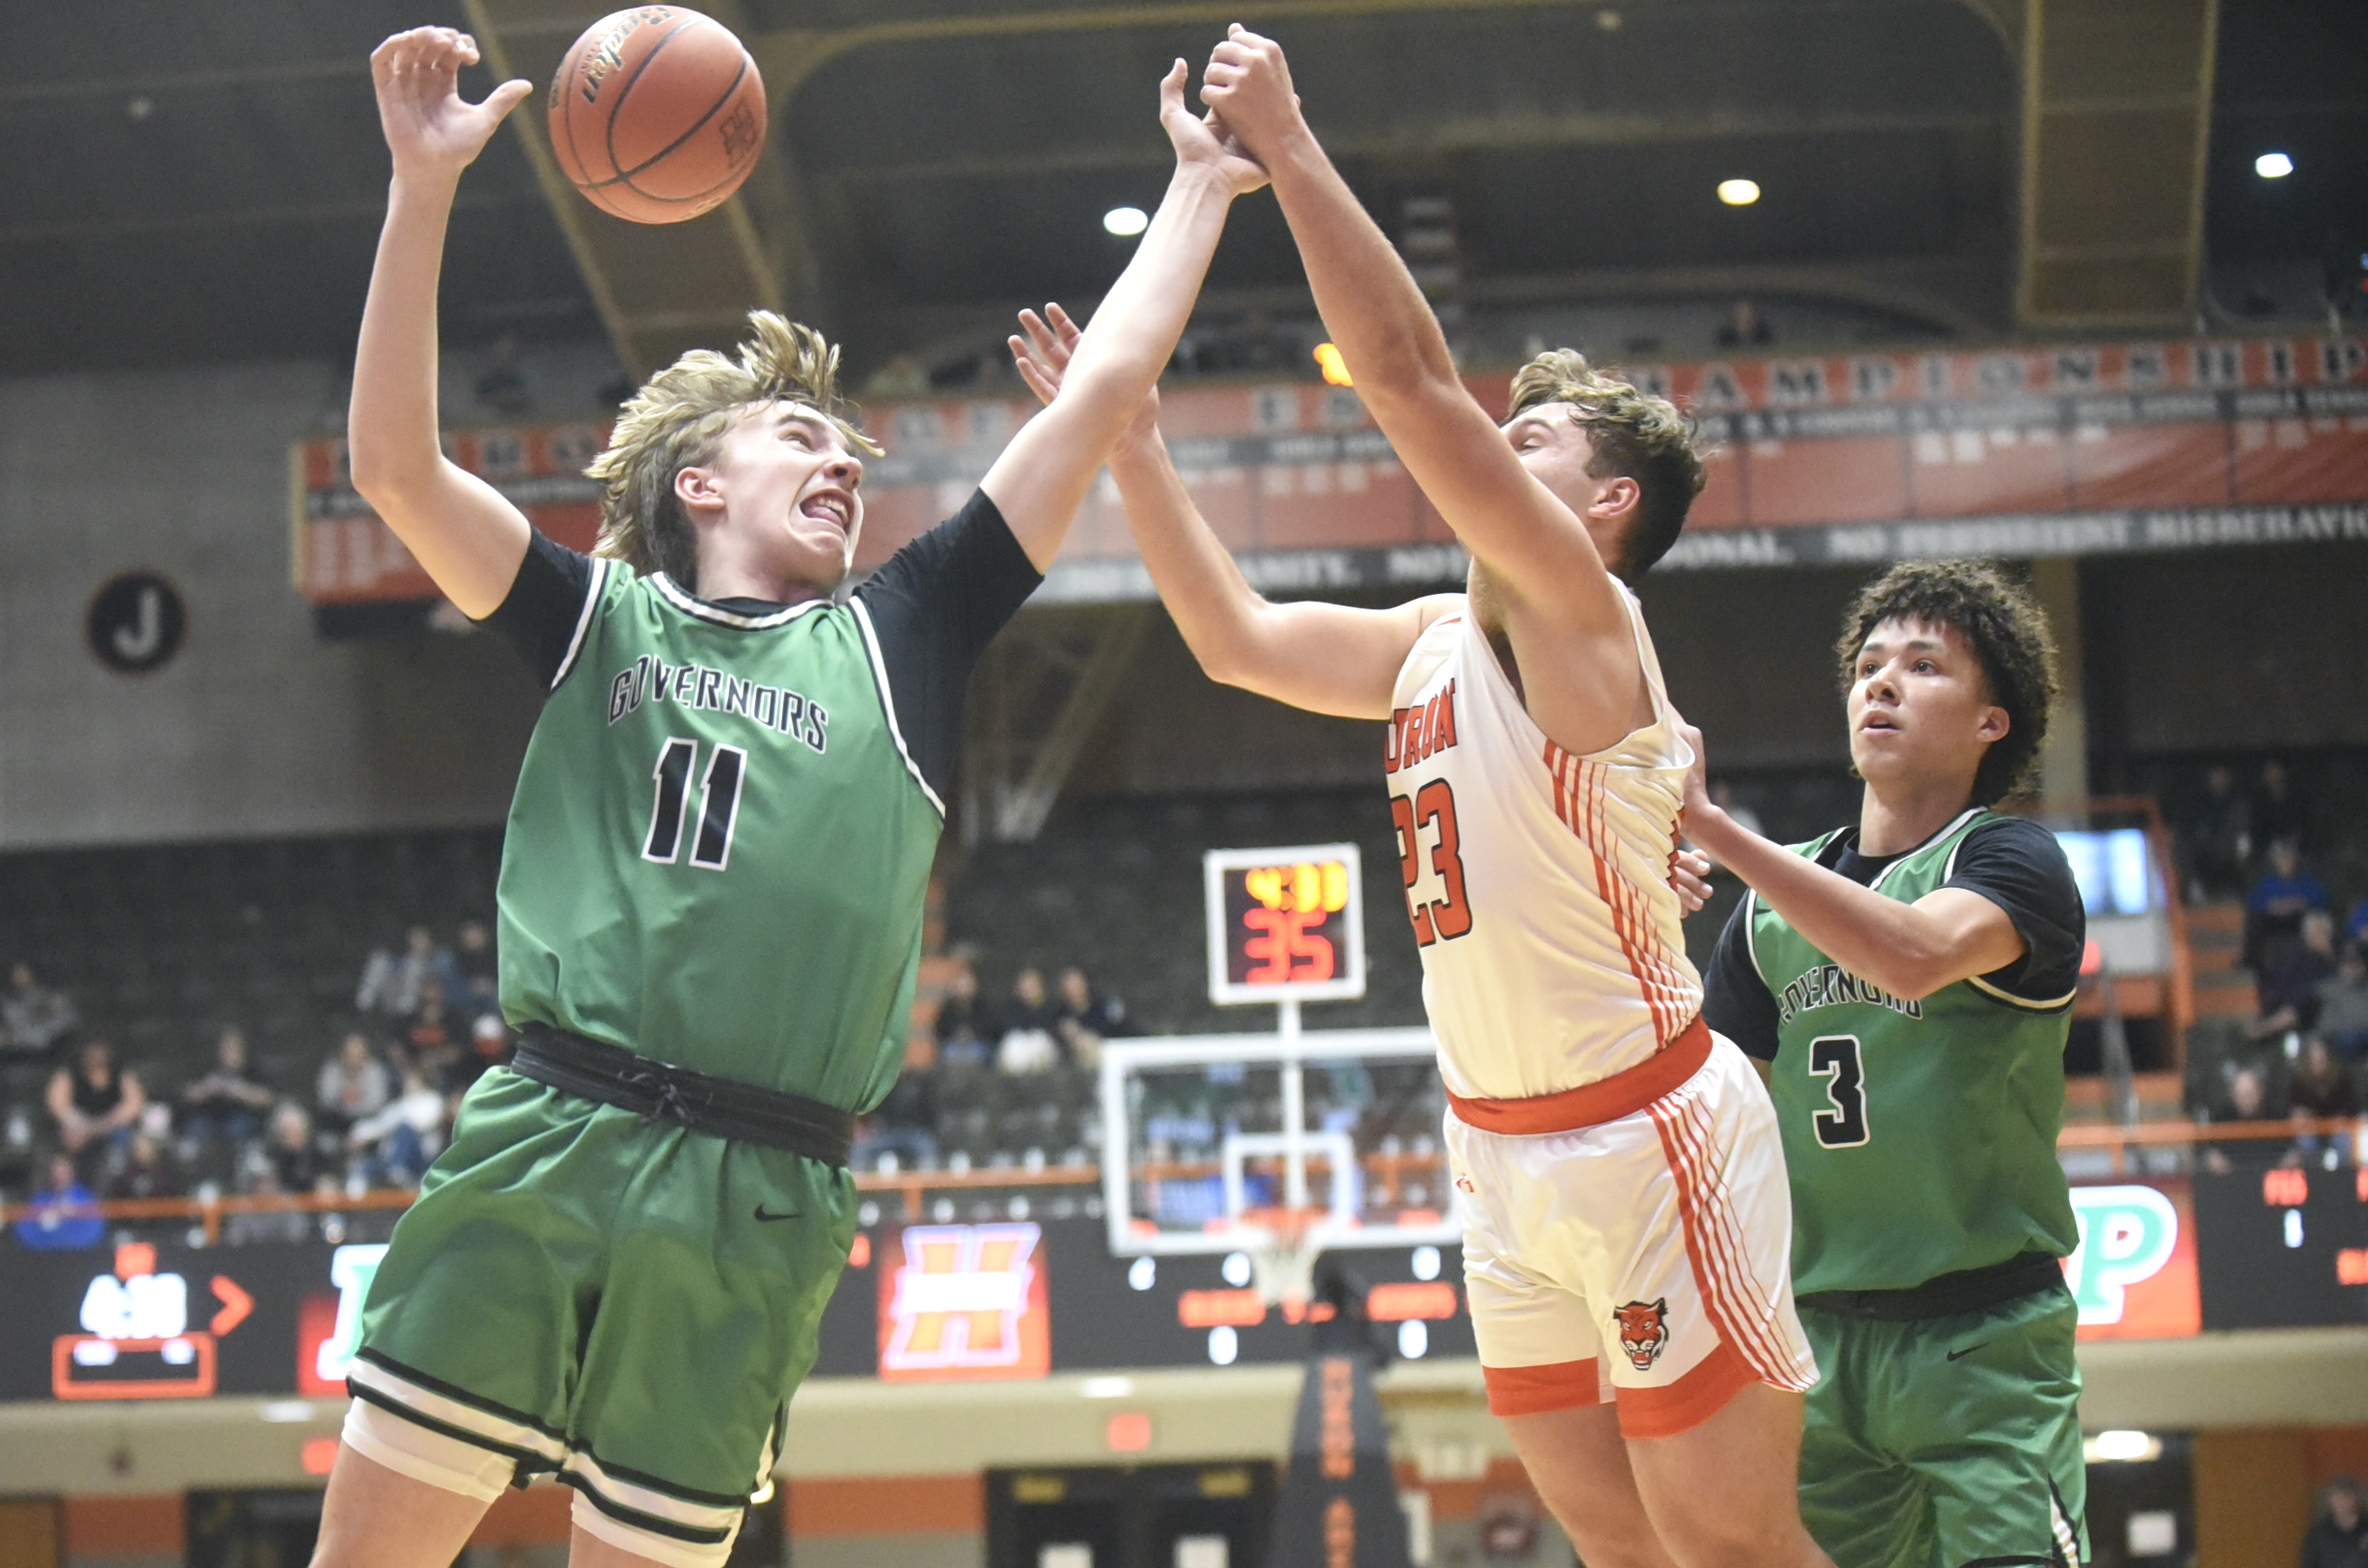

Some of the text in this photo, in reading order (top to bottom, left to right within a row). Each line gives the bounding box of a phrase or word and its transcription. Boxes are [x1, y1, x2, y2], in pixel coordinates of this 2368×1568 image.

[582, 6, 674, 105] Baden
[1625, 338, 2367, 411] HAMPIONSHIP
[115, 588, 159, 659] J
[608, 653, 830, 755] GOVERNORS
[1385, 677, 1458, 773] URON
[641, 735, 748, 872] 11
[1391, 777, 1473, 948] 23
[1243, 908, 1334, 988] 35
[1809, 1034, 1871, 1150] 3
[882, 1223, 1041, 1370] H
[2069, 1185, 2179, 1324] P
